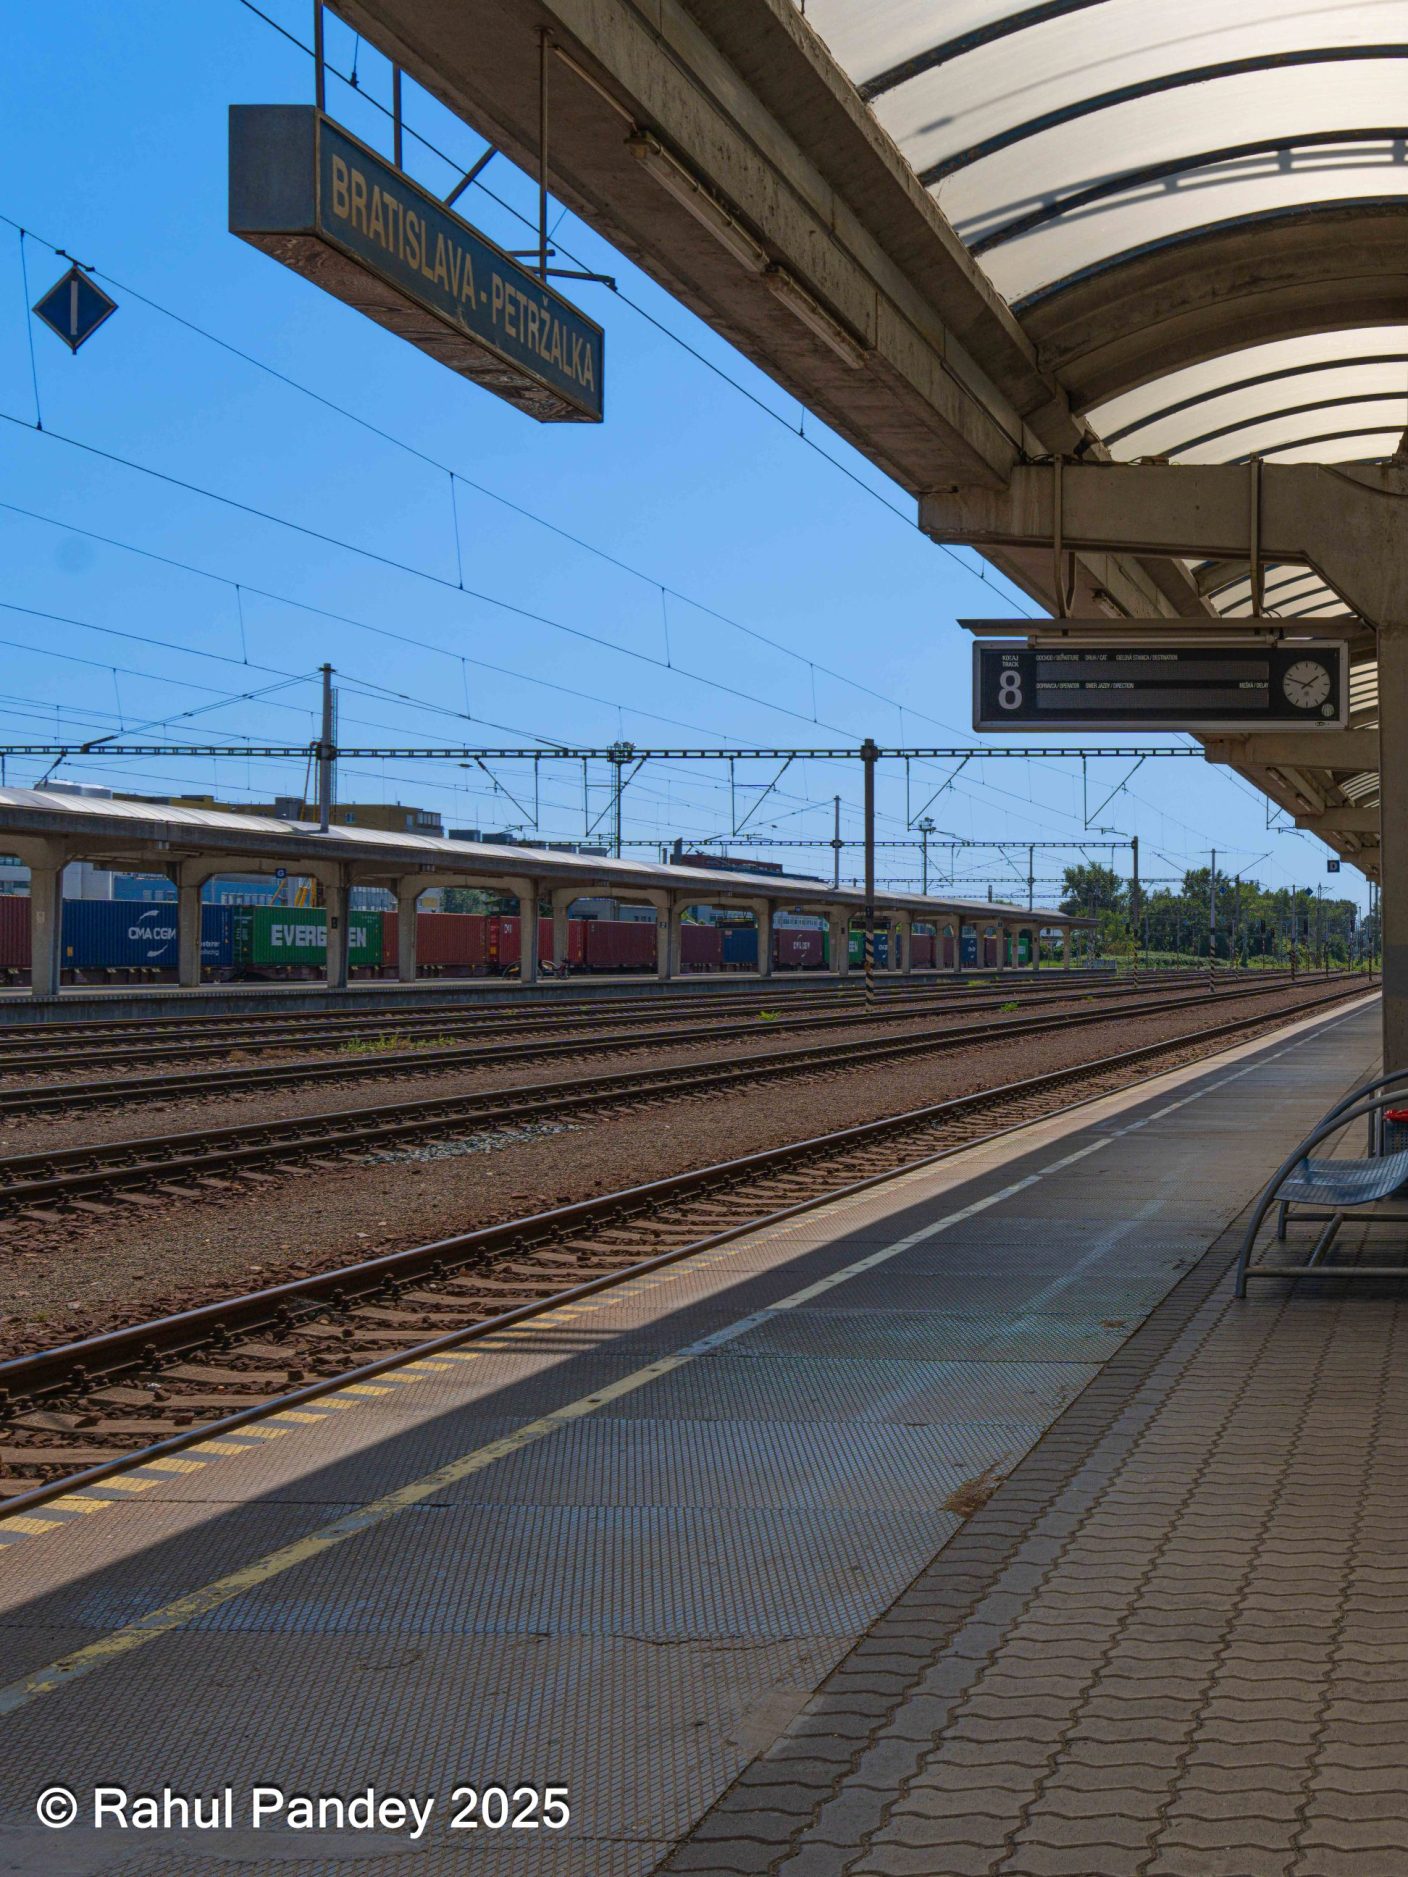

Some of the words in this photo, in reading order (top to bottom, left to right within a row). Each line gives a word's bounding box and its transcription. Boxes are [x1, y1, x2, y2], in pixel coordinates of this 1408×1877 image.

[332, 153, 476, 311] BRATISLAVA
[491, 271, 595, 392] PETRŽALKA
[998, 670, 1023, 710] 8
[1329, 861, 1338, 871] D
[127, 927, 152, 940] CMA
[271, 924, 367, 948] EVERGEN
